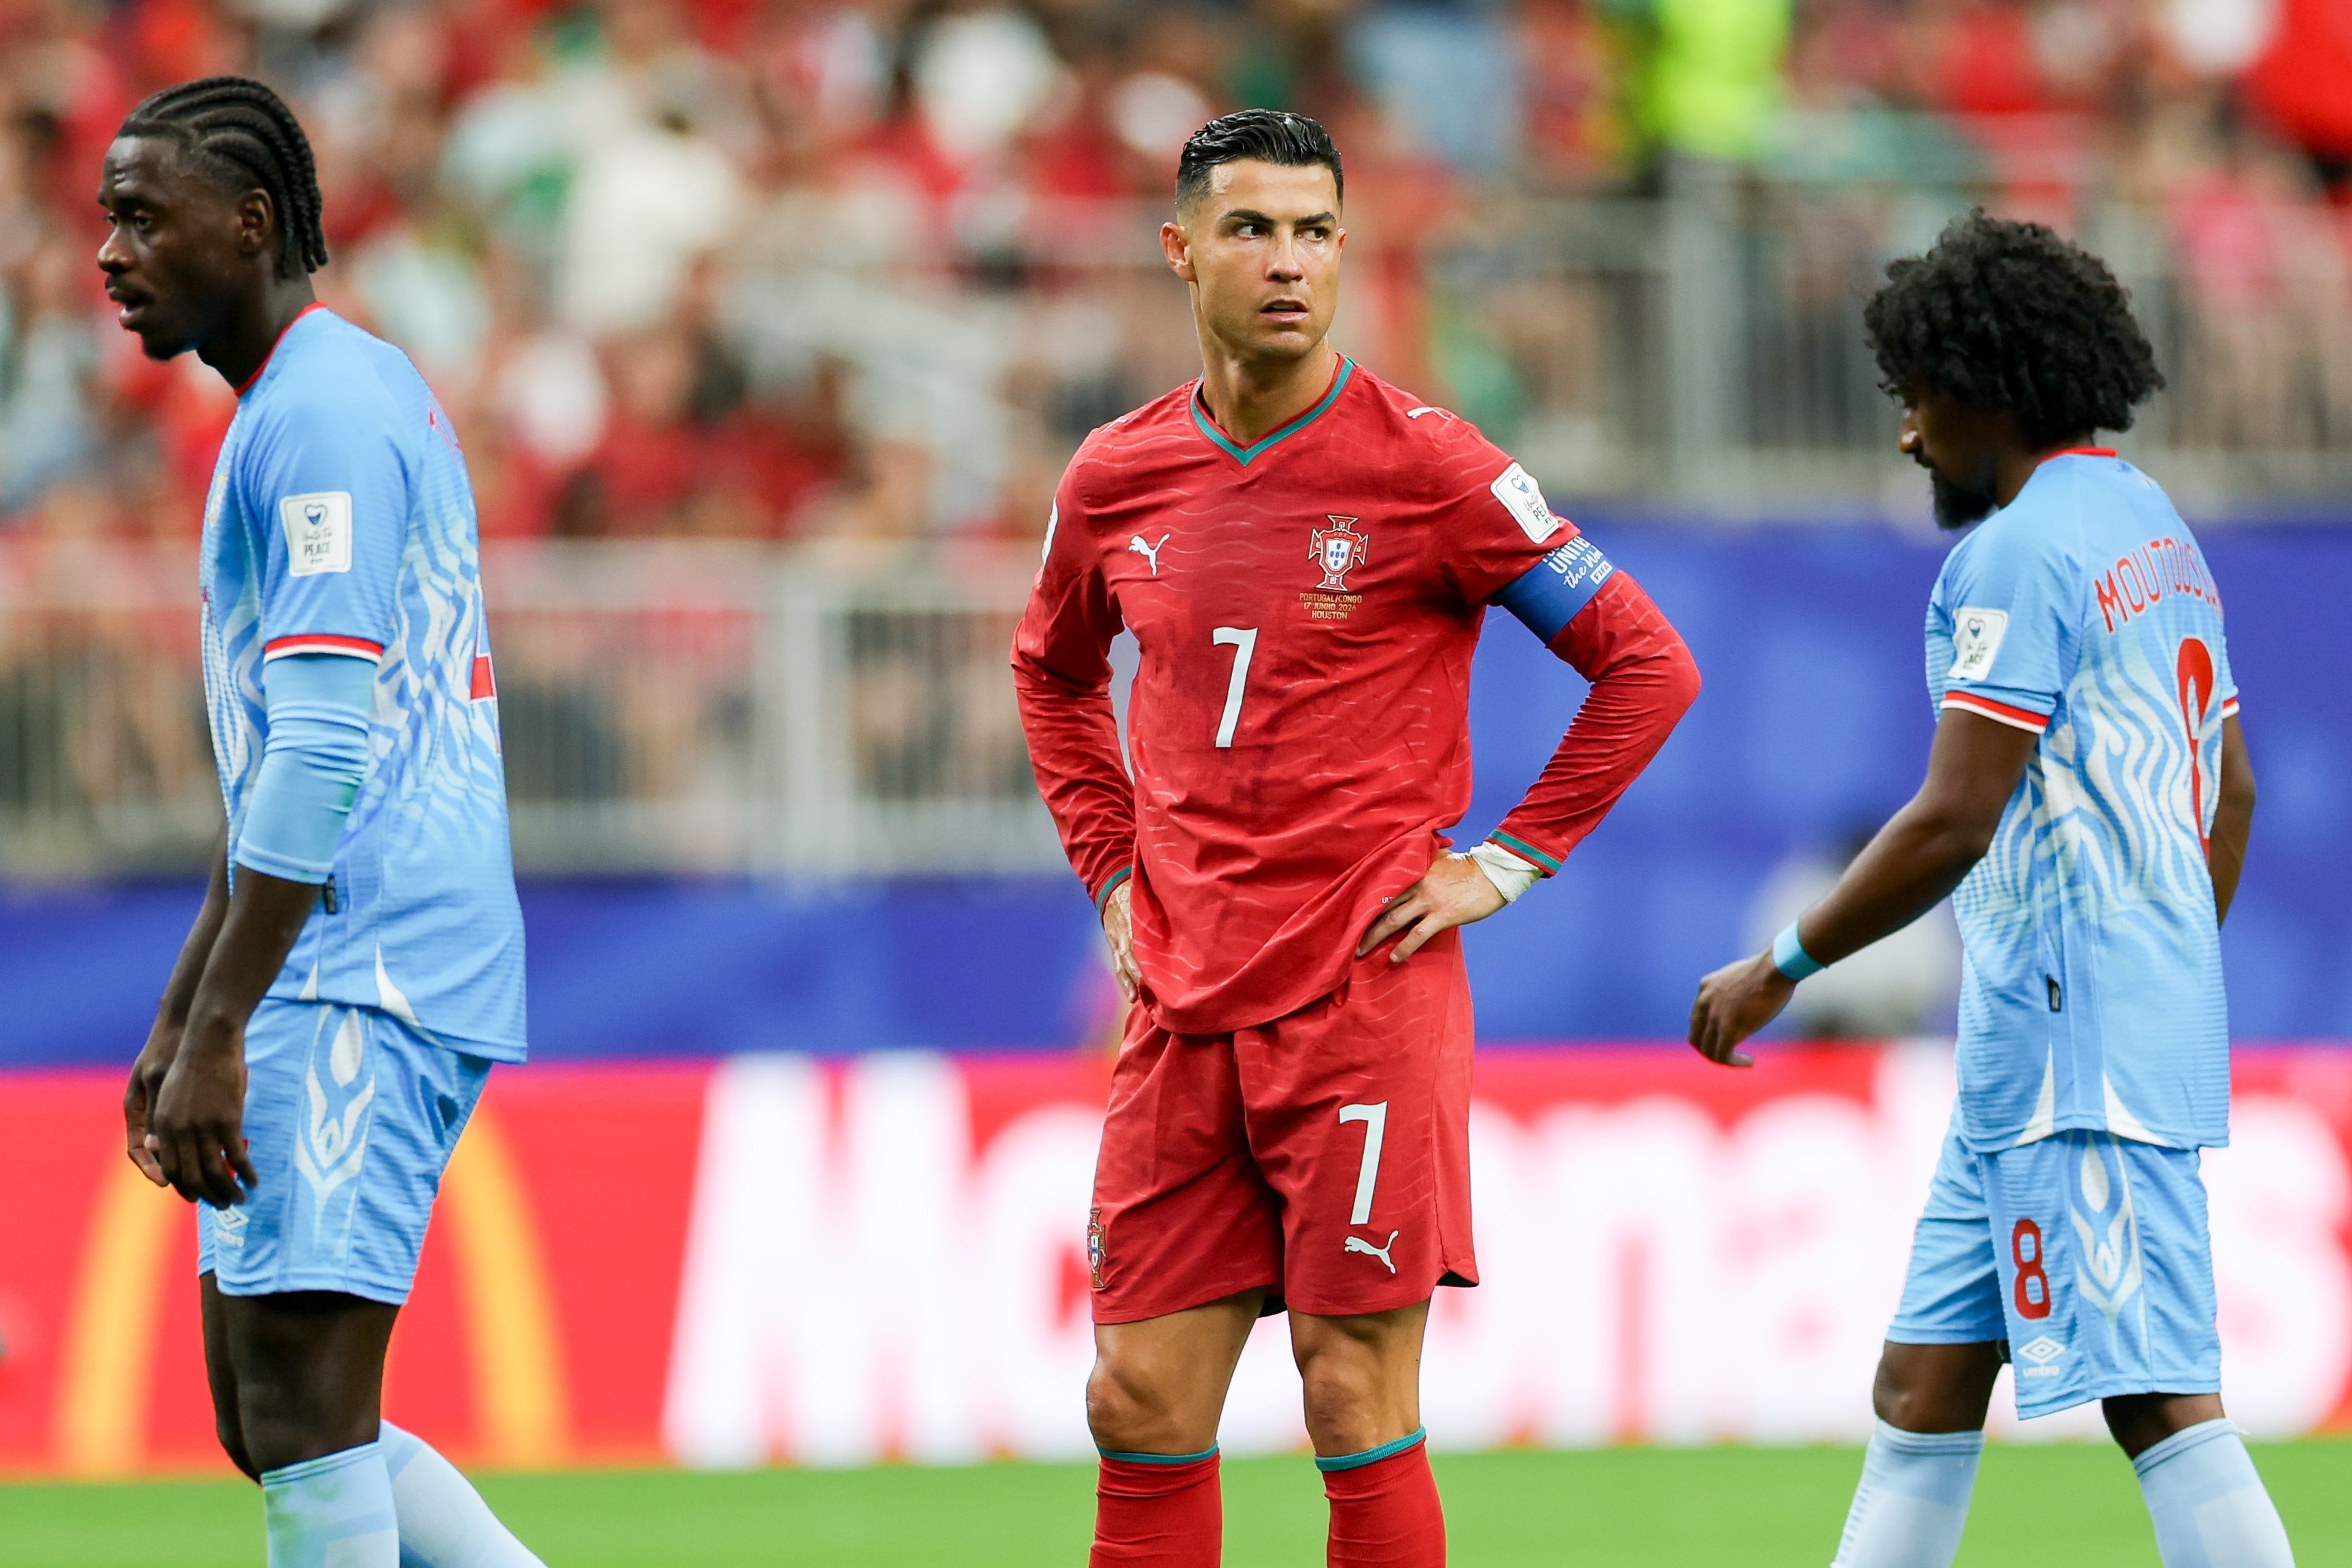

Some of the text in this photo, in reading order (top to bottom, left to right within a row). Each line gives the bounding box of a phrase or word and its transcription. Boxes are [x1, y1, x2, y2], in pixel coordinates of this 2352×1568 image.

[1563, 565, 1587, 589] the
[1594, 563, 1610, 580] FIFA
[1299, 592, 1363, 604] PORTUGAL/CONGO
[1303, 601, 1312, 610] 17
[1313, 602, 1337, 611] JUNHO
[1312, 610, 1348, 620] HOUSTON
[1212, 626, 1259, 748] 7
[1338, 1099, 1388, 1226] 7
[2012, 1217, 2052, 1320] 8
